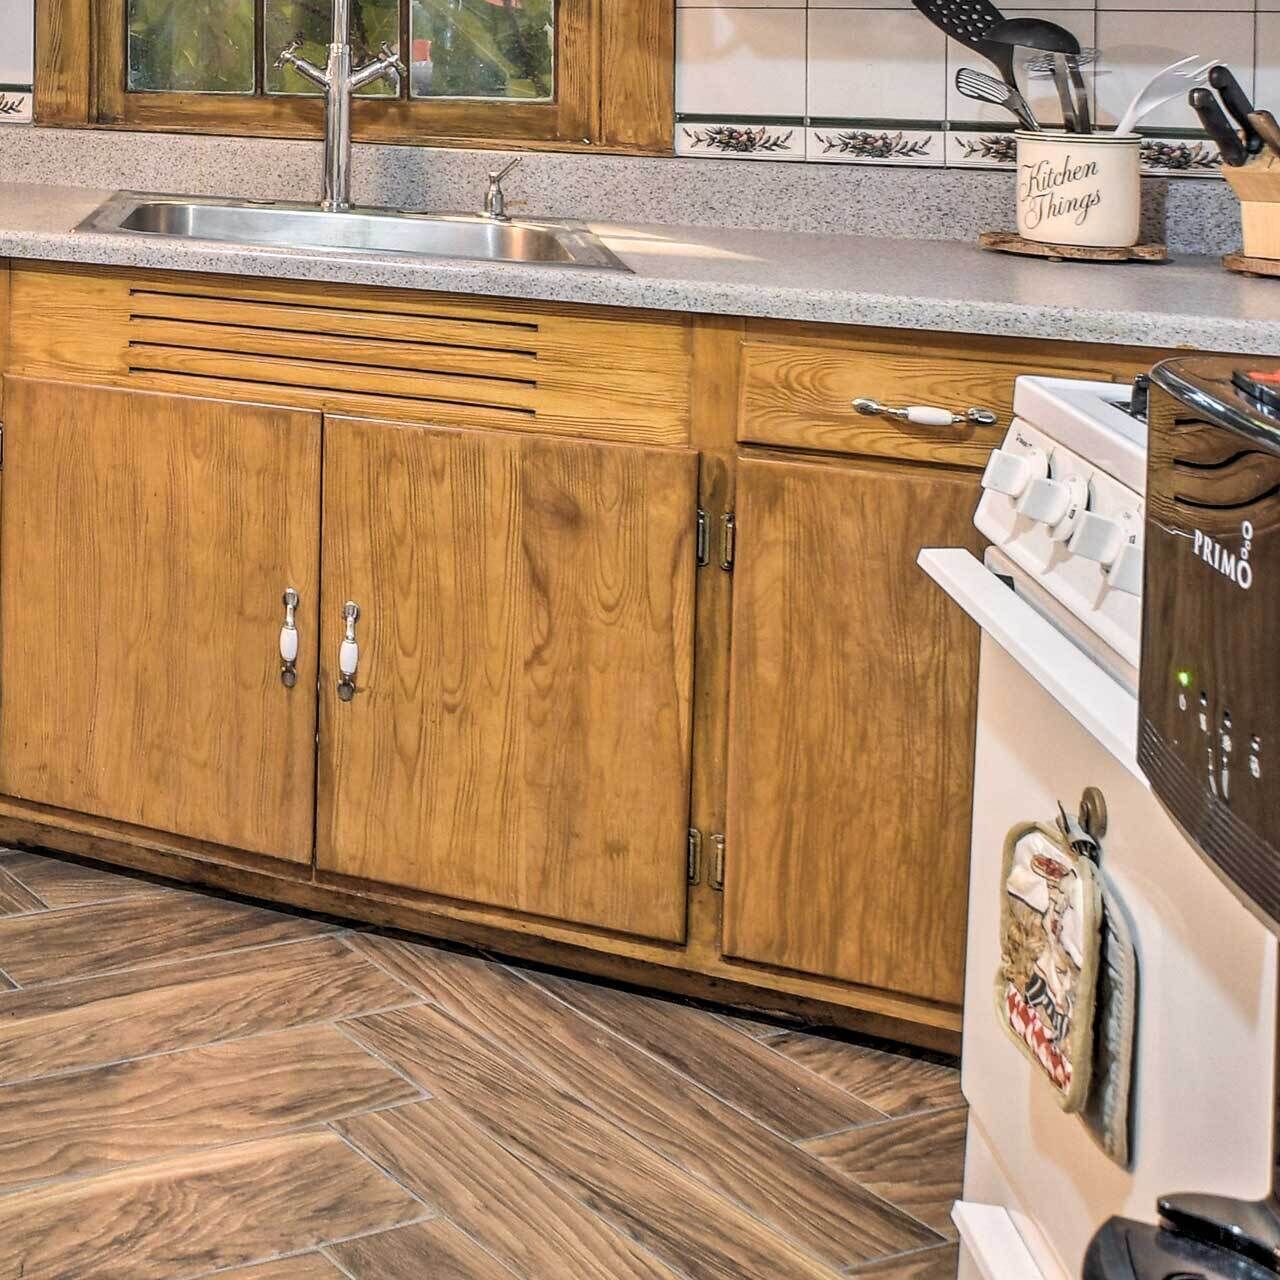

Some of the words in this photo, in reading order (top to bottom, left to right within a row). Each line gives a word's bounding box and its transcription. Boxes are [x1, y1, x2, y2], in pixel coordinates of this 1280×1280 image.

[1021, 155, 1098, 201] Kitchen
[1025, 188, 1101, 230] Things
[1194, 527, 1253, 589] PRIMO
